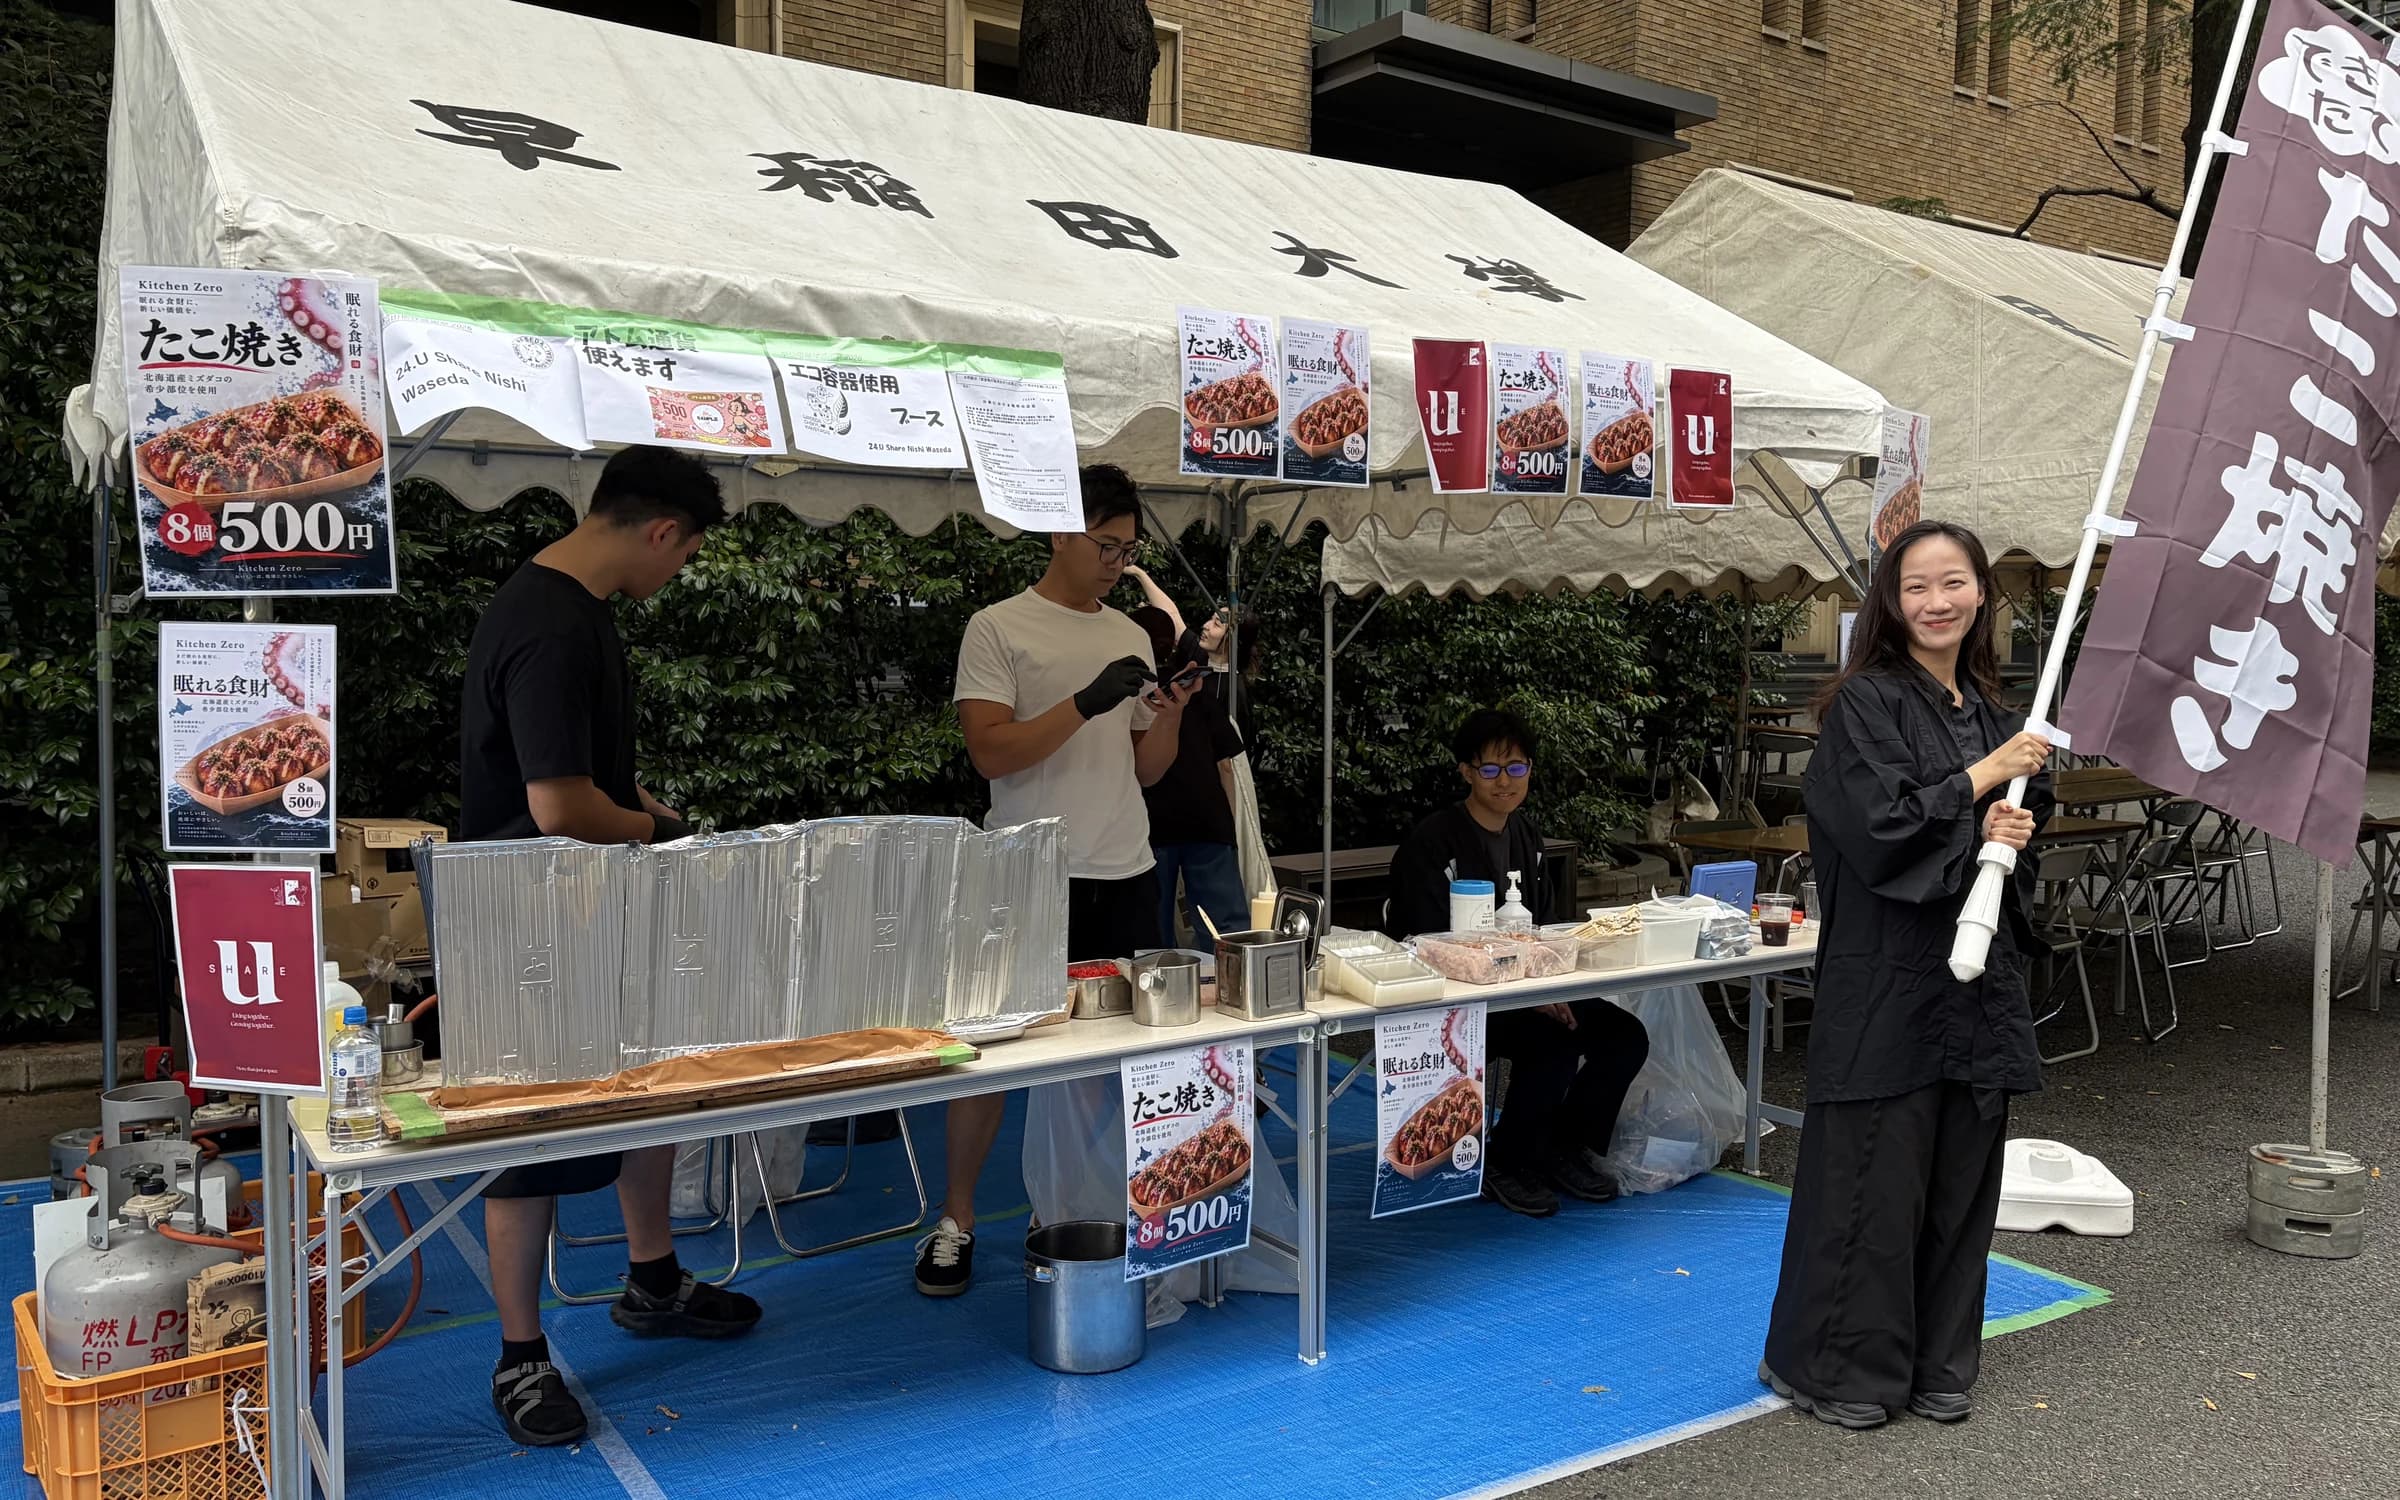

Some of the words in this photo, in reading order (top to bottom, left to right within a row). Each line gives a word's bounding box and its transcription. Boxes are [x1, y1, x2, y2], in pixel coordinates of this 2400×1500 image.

[139, 280, 189, 291] Kitchen
[193, 282, 223, 293] Zero
[345, 292, 363, 357] 眠れる食財
[138, 318, 304, 368] たこ焼き
[1187, 333, 1248, 360] たこ焼き
[395, 351, 429, 381] 24.U
[434, 351, 482, 378] Share
[484, 370, 527, 392] Nishi
[582, 346, 678, 382] 使えます
[1288, 354, 1338, 375] 眠れる食財
[143, 372, 233, 385] 北海道産ミズダコの
[143, 383, 218, 396] 希少部位を使用
[401, 373, 470, 403] Waseda
[788, 363, 900, 395] エコ容器使用
[1499, 368, 1546, 391] たこ焼き
[662, 401, 687, 419] 500
[890, 407, 944, 427] ブース
[907, 444, 924, 453] Nishi
[925, 446, 952, 454] Waseda
[1213, 427, 1273, 457] 500円
[1517, 451, 1563, 475] 500円
[2169, 165, 2400, 773] たこ焼き
[166, 512, 216, 545] 8個
[219, 501, 375, 553] 500円
[238, 564, 276, 573] Kitchen
[279, 564, 302, 573] Zero
[176, 639, 217, 649] Kitchen
[220, 640, 245, 649] Zero
[173, 673, 271, 699] 眠れる食財
[297, 781, 314, 794] 8個
[288, 796, 321, 809] 500円
[208, 964, 287, 977] SHARE
[1383, 1024, 1411, 1034] Kitchen
[1413, 1021, 1430, 1030] Zero
[1130, 1062, 1158, 1073] Kitchen
[1159, 1060, 1175, 1069] Zero
[1382, 1051, 1446, 1075] 眠れる食財
[1132, 1081, 1215, 1122] たこ焼き
[1139, 1221, 1164, 1243] 8個
[1165, 1195, 1242, 1241] 500円
[81, 1318, 119, 1348] 燃
[81, 1351, 112, 1371] FP
